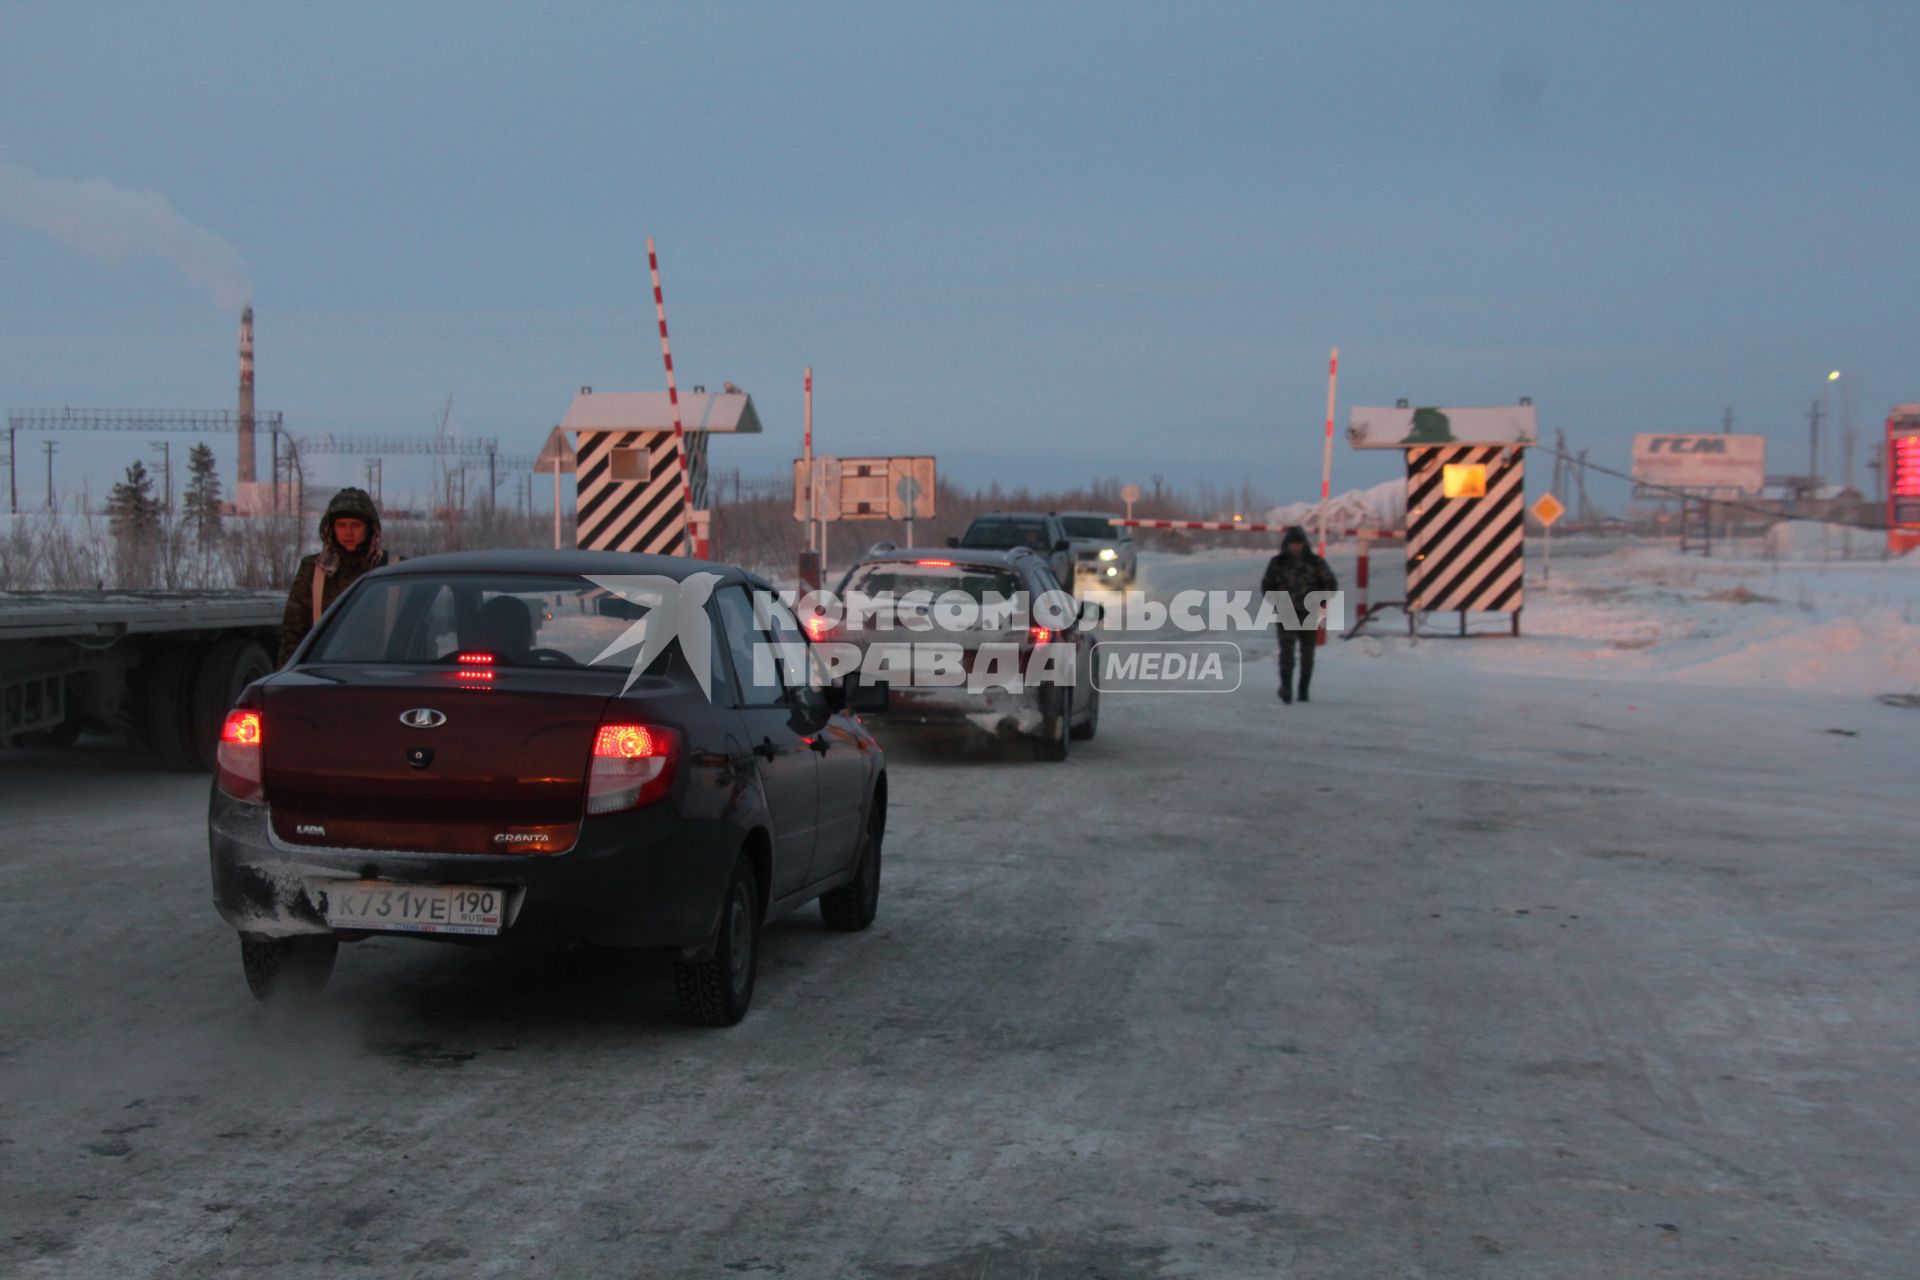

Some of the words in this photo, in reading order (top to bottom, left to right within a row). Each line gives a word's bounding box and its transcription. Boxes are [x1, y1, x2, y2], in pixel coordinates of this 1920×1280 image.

[297, 824, 326, 836] LADA
[493, 833, 549, 842] GRANTA
[455, 892, 494, 913] 190
[461, 914, 482, 922] RUS
